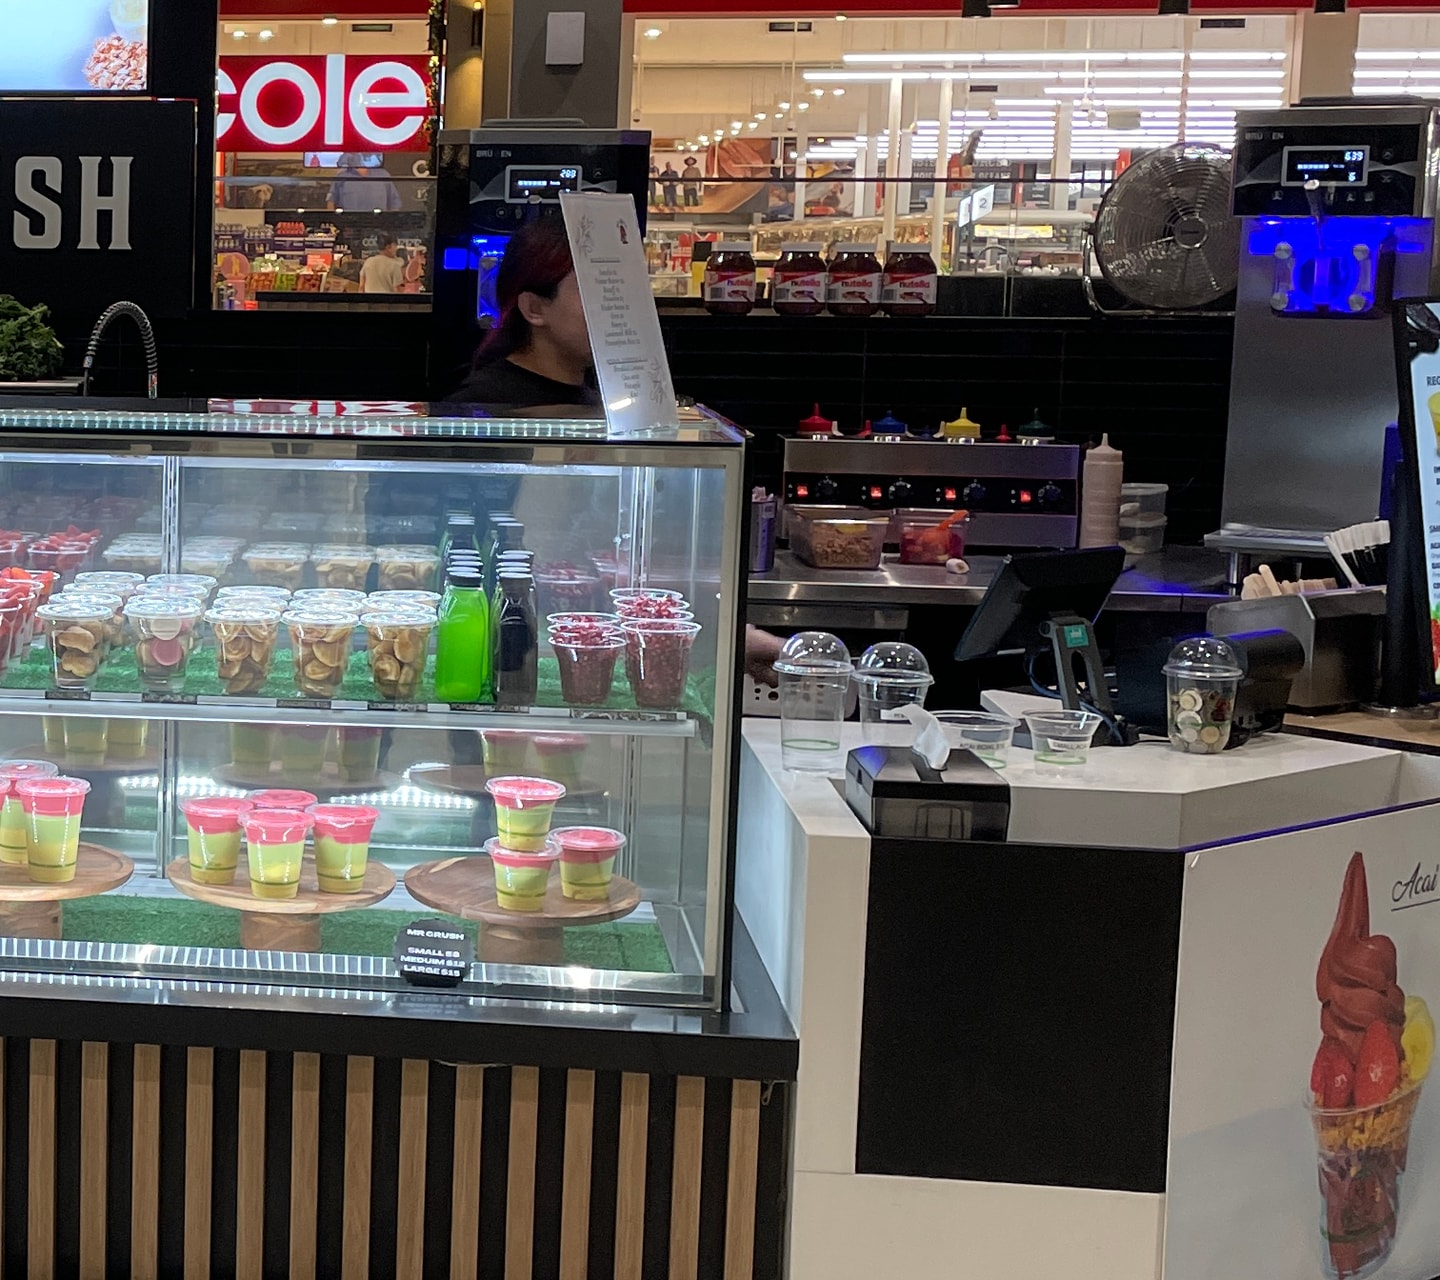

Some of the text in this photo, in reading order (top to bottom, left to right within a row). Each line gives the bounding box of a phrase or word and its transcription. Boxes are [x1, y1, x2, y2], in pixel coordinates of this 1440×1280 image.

[979, 198, 987, 209] 2
[726, 278, 753, 287] nutella
[791, 278, 821, 288] nutella
[841, 279, 873, 289] nutella
[899, 279, 931, 289] nutella
[406, 928, 425, 937] MR
[407, 946, 445, 957] SMALL
[403, 964, 441, 975] LARGE
